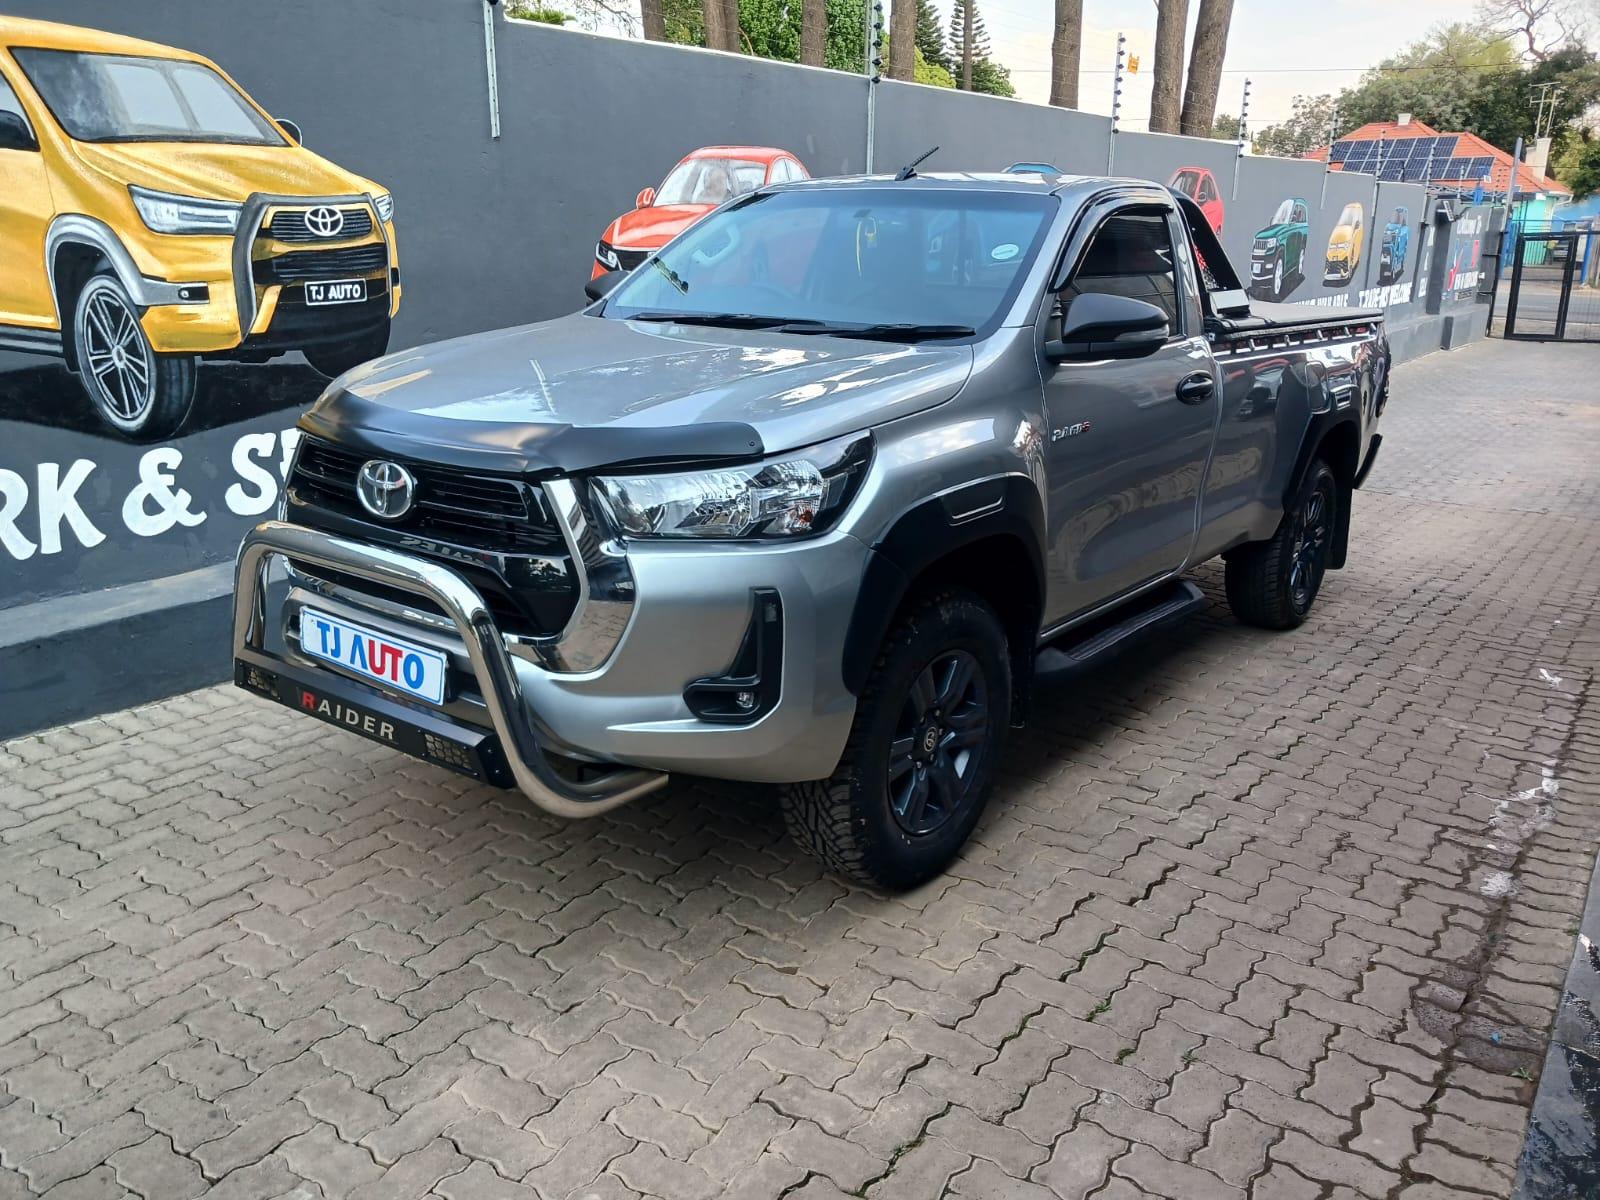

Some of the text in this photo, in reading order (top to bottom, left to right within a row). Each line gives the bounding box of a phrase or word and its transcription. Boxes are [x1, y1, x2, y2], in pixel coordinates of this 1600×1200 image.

[309, 284, 361, 301] TJ AUTO
[122, 447, 208, 537] &
[316, 620, 425, 690] TJ AUTO
[301, 690, 395, 741] RAIDER
